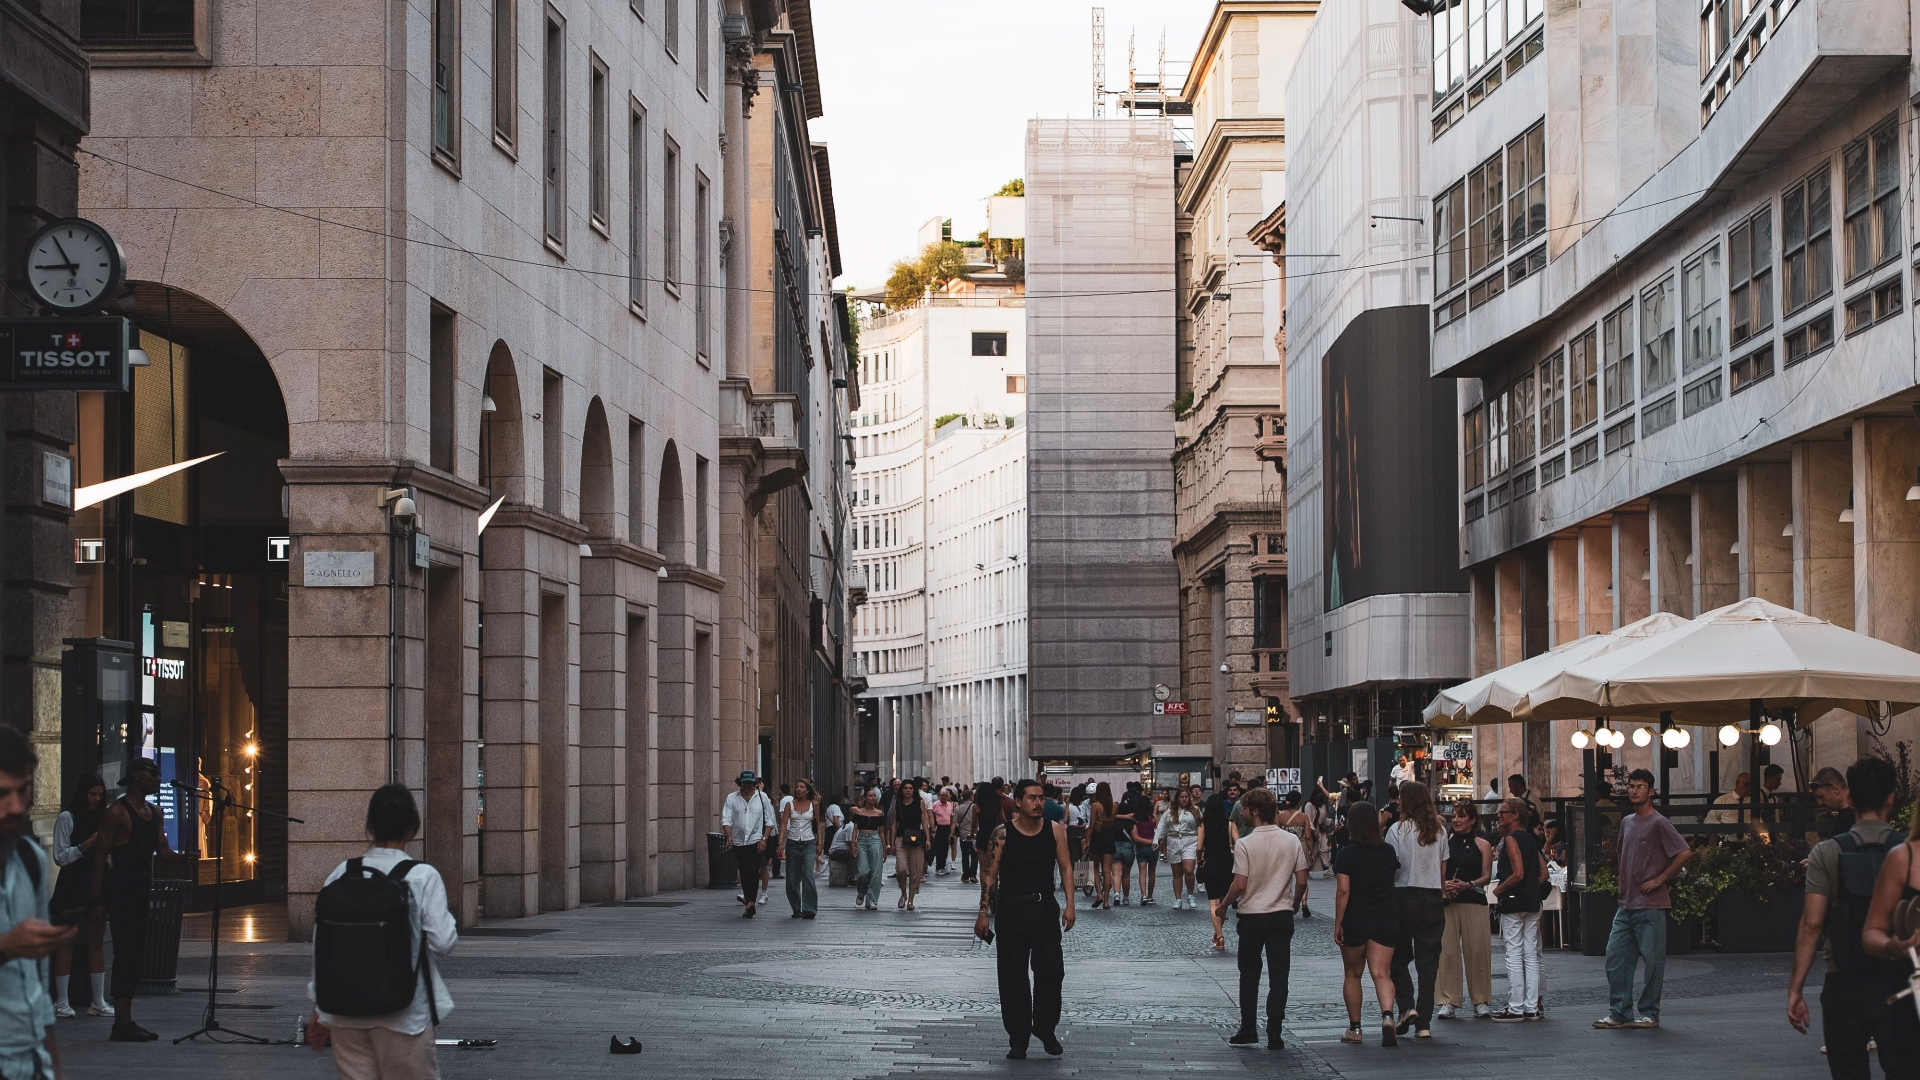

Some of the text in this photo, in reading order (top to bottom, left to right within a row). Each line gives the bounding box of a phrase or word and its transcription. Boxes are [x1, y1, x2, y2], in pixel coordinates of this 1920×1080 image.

[20, 350, 110, 367] TISSOT
[317, 569, 361, 578] AGNELLO
[157, 658, 185, 680] TISSOT
[1450, 741, 1468, 751] ICE
[1444, 750, 1473, 760] CREA
